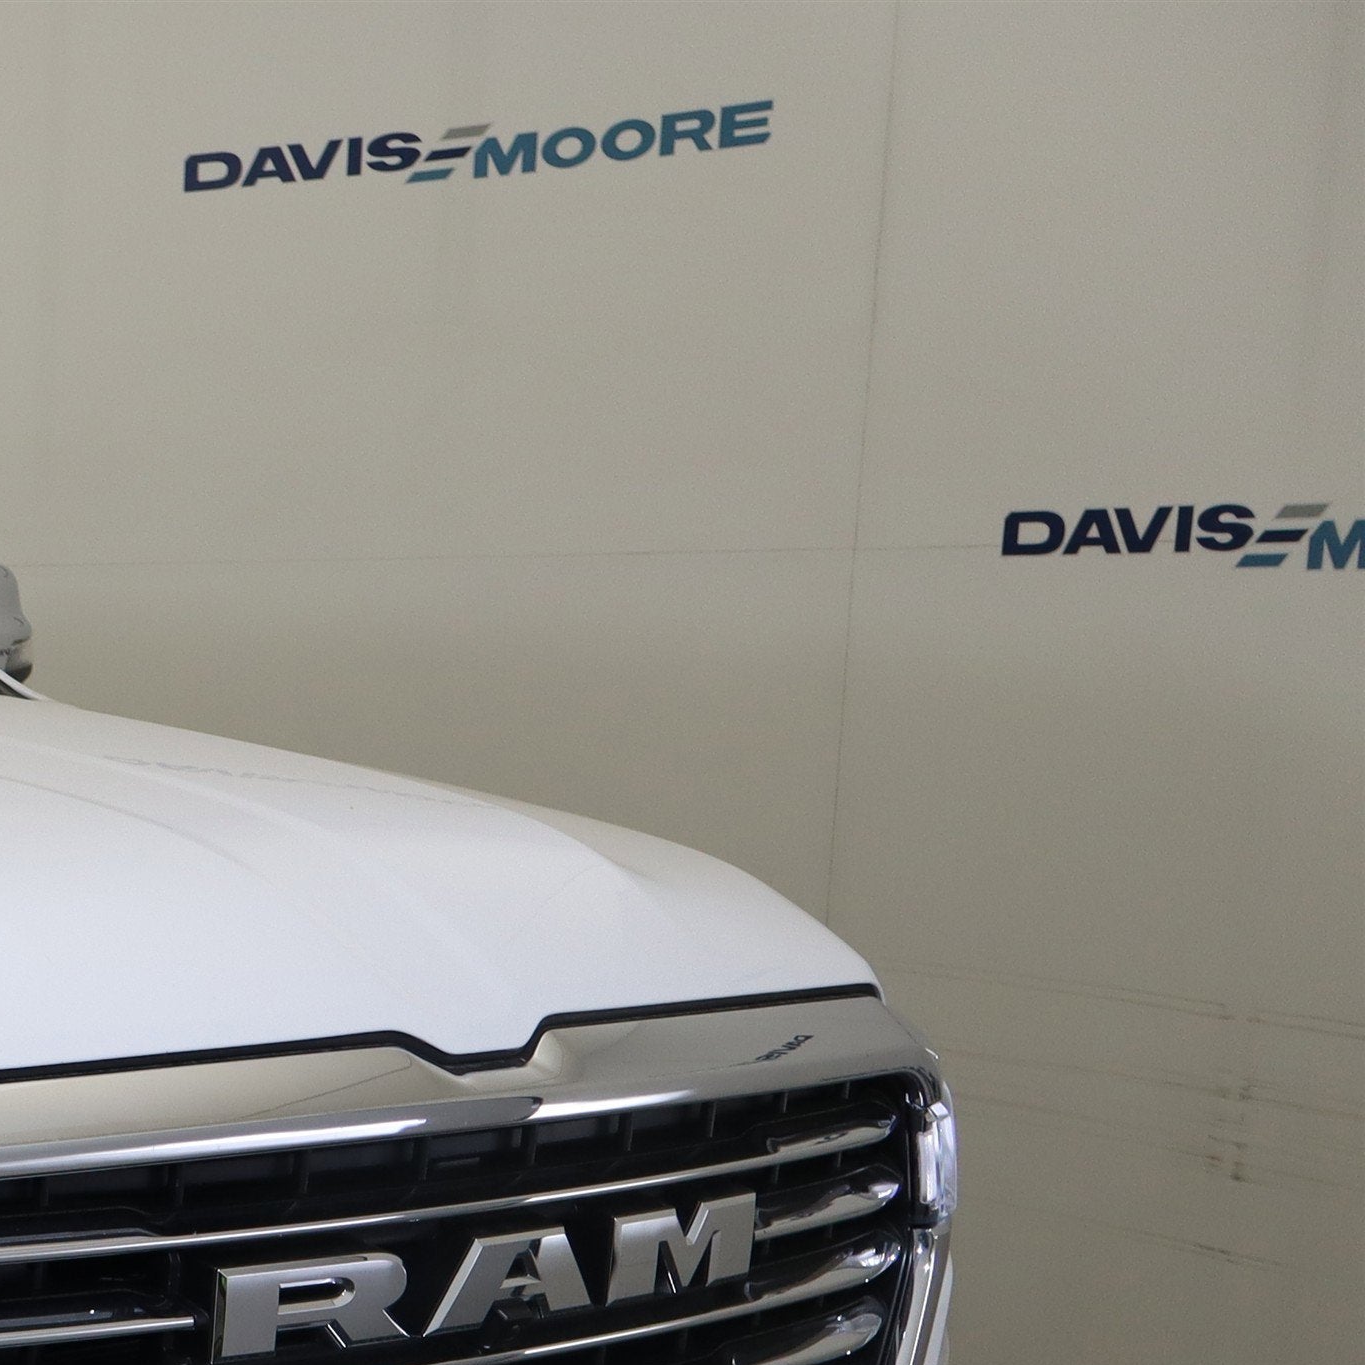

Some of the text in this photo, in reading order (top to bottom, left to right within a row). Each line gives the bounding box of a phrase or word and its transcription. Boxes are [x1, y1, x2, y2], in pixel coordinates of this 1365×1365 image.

[184, 100, 774, 192] DAVIS MOORE
[1001, 504, 1256, 556] DAVIS
[208, 1192, 757, 1365] RAM
